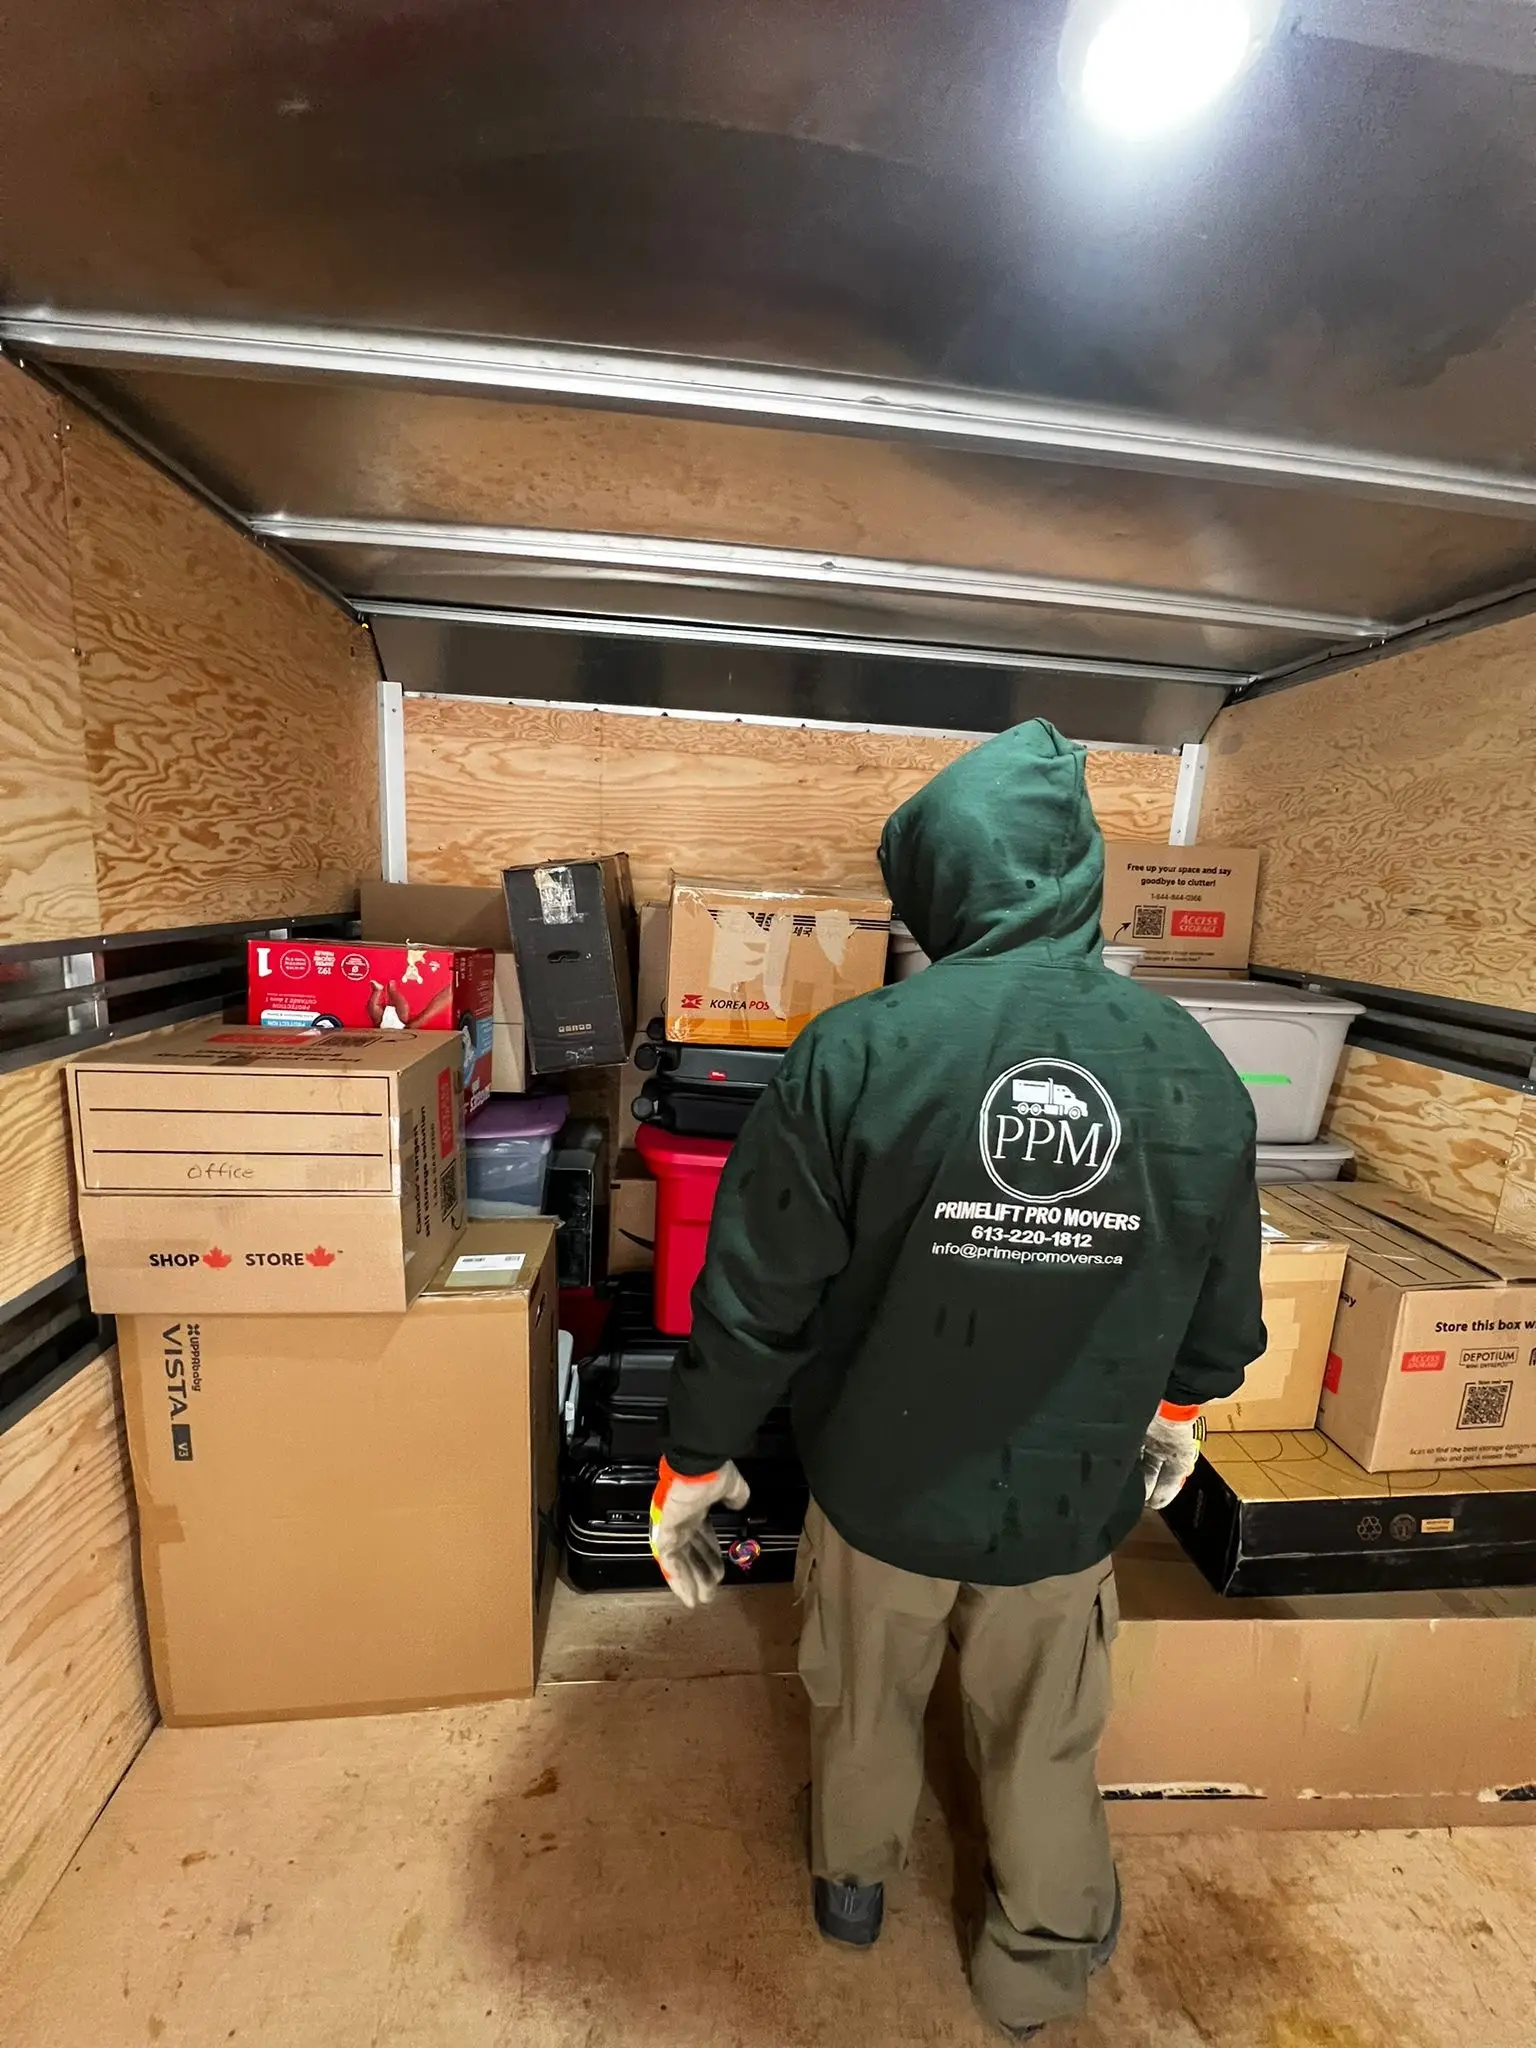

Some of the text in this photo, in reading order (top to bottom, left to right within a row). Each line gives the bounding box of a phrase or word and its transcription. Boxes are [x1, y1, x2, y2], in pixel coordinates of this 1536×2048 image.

[1127, 863, 1232, 877] Free up your space and say
[1140, 878, 1176, 887] goodbye
[1187, 879, 1217, 888] clutter!
[1180, 915, 1219, 925] ACCESS
[709, 999, 770, 1011] KOREA POS
[991, 1113, 1104, 1168] PPM
[934, 1201, 1141, 1232] PRIMELIFT PRO MOVERS
[971, 1225, 1093, 1248] 613-220-1812
[149, 1252, 305, 1267] SHOP STORE
[931, 1242, 1124, 1266] info@primepromovers.ca
[1435, 1320, 1468, 1333] Store
[1471, 1319, 1495, 1332] this
[1497, 1318, 1522, 1331] box
[1463, 1350, 1515, 1362] DEPOTIUM
[162, 1323, 189, 1421] VISTA
